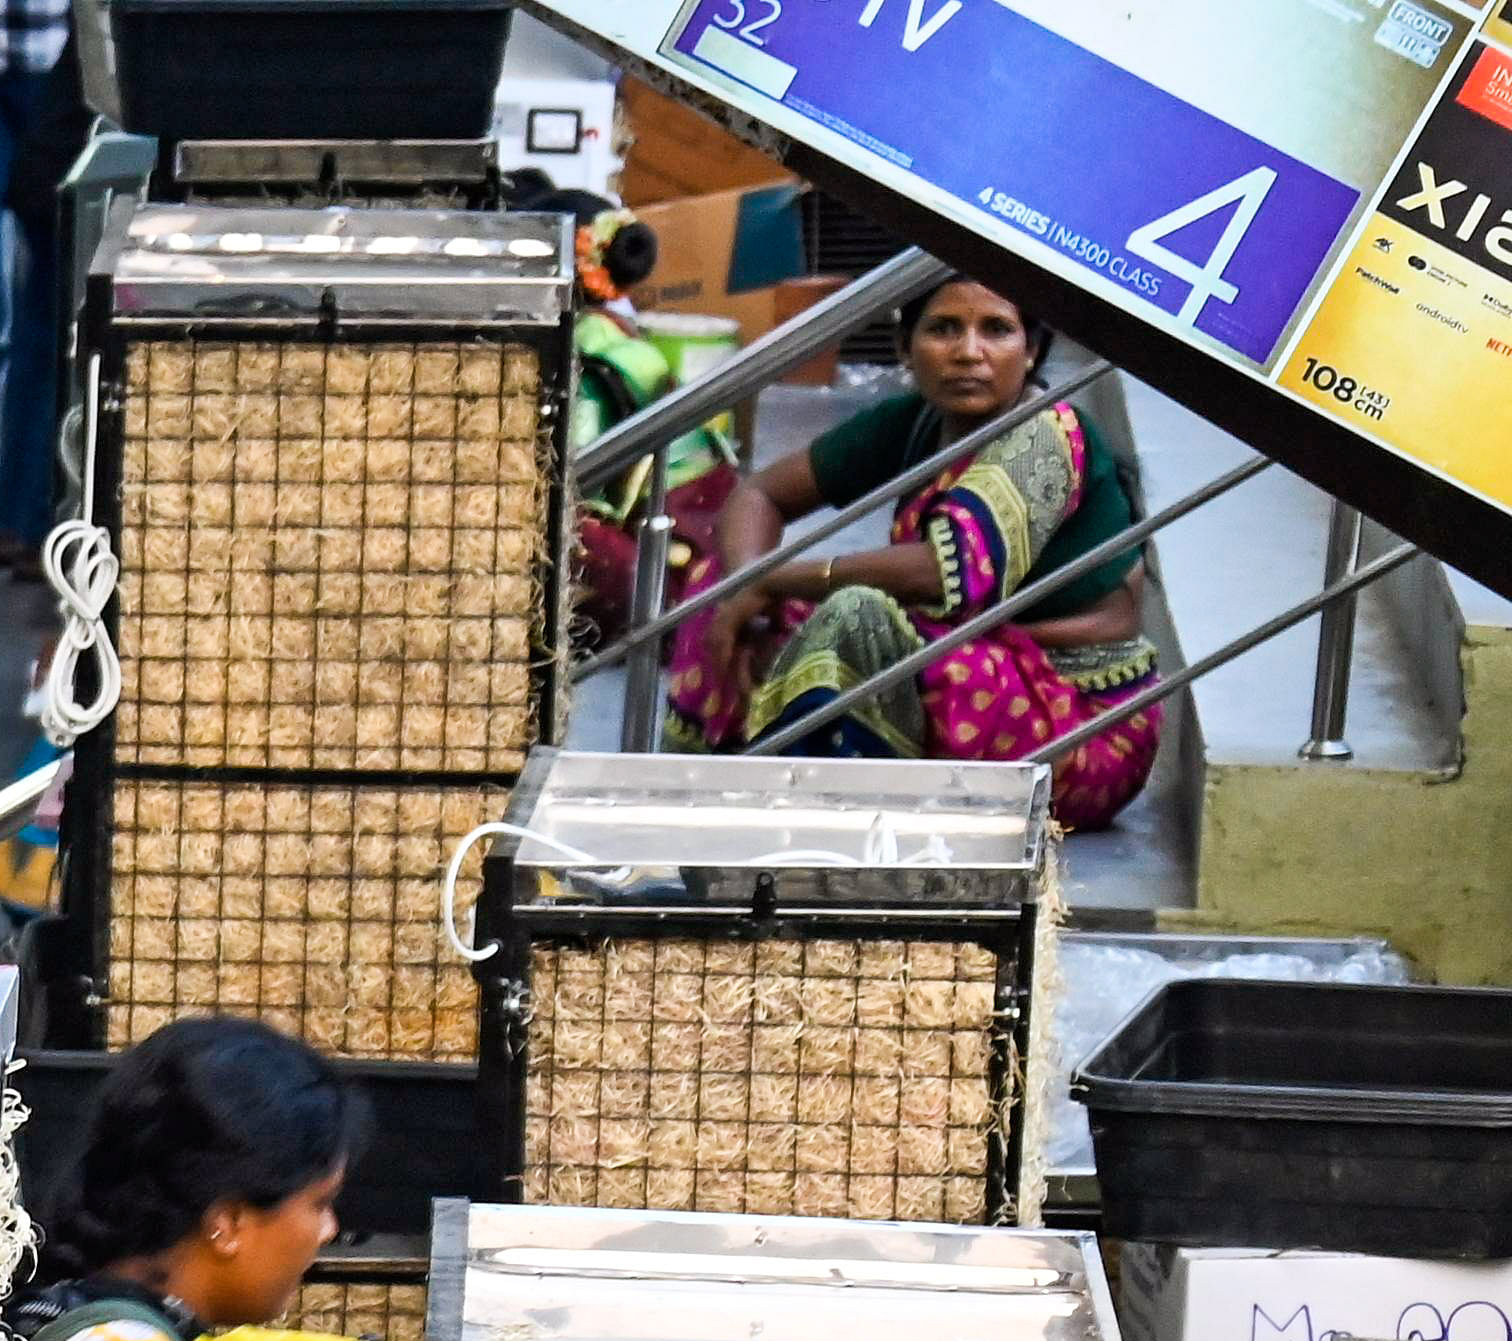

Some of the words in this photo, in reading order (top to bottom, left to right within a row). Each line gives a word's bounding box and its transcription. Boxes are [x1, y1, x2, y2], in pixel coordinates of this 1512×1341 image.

[1394, 3, 1445, 41] FRONT
[978, 186, 994, 205] 4
[991, 191, 1051, 236] SERIES
[1058, 230, 1110, 268] N4300
[1109, 257, 1162, 297] CLASS
[1125, 165, 1277, 329] 4
[1302, 357, 1358, 403] 108
[1354, 398, 1385, 422] cm
